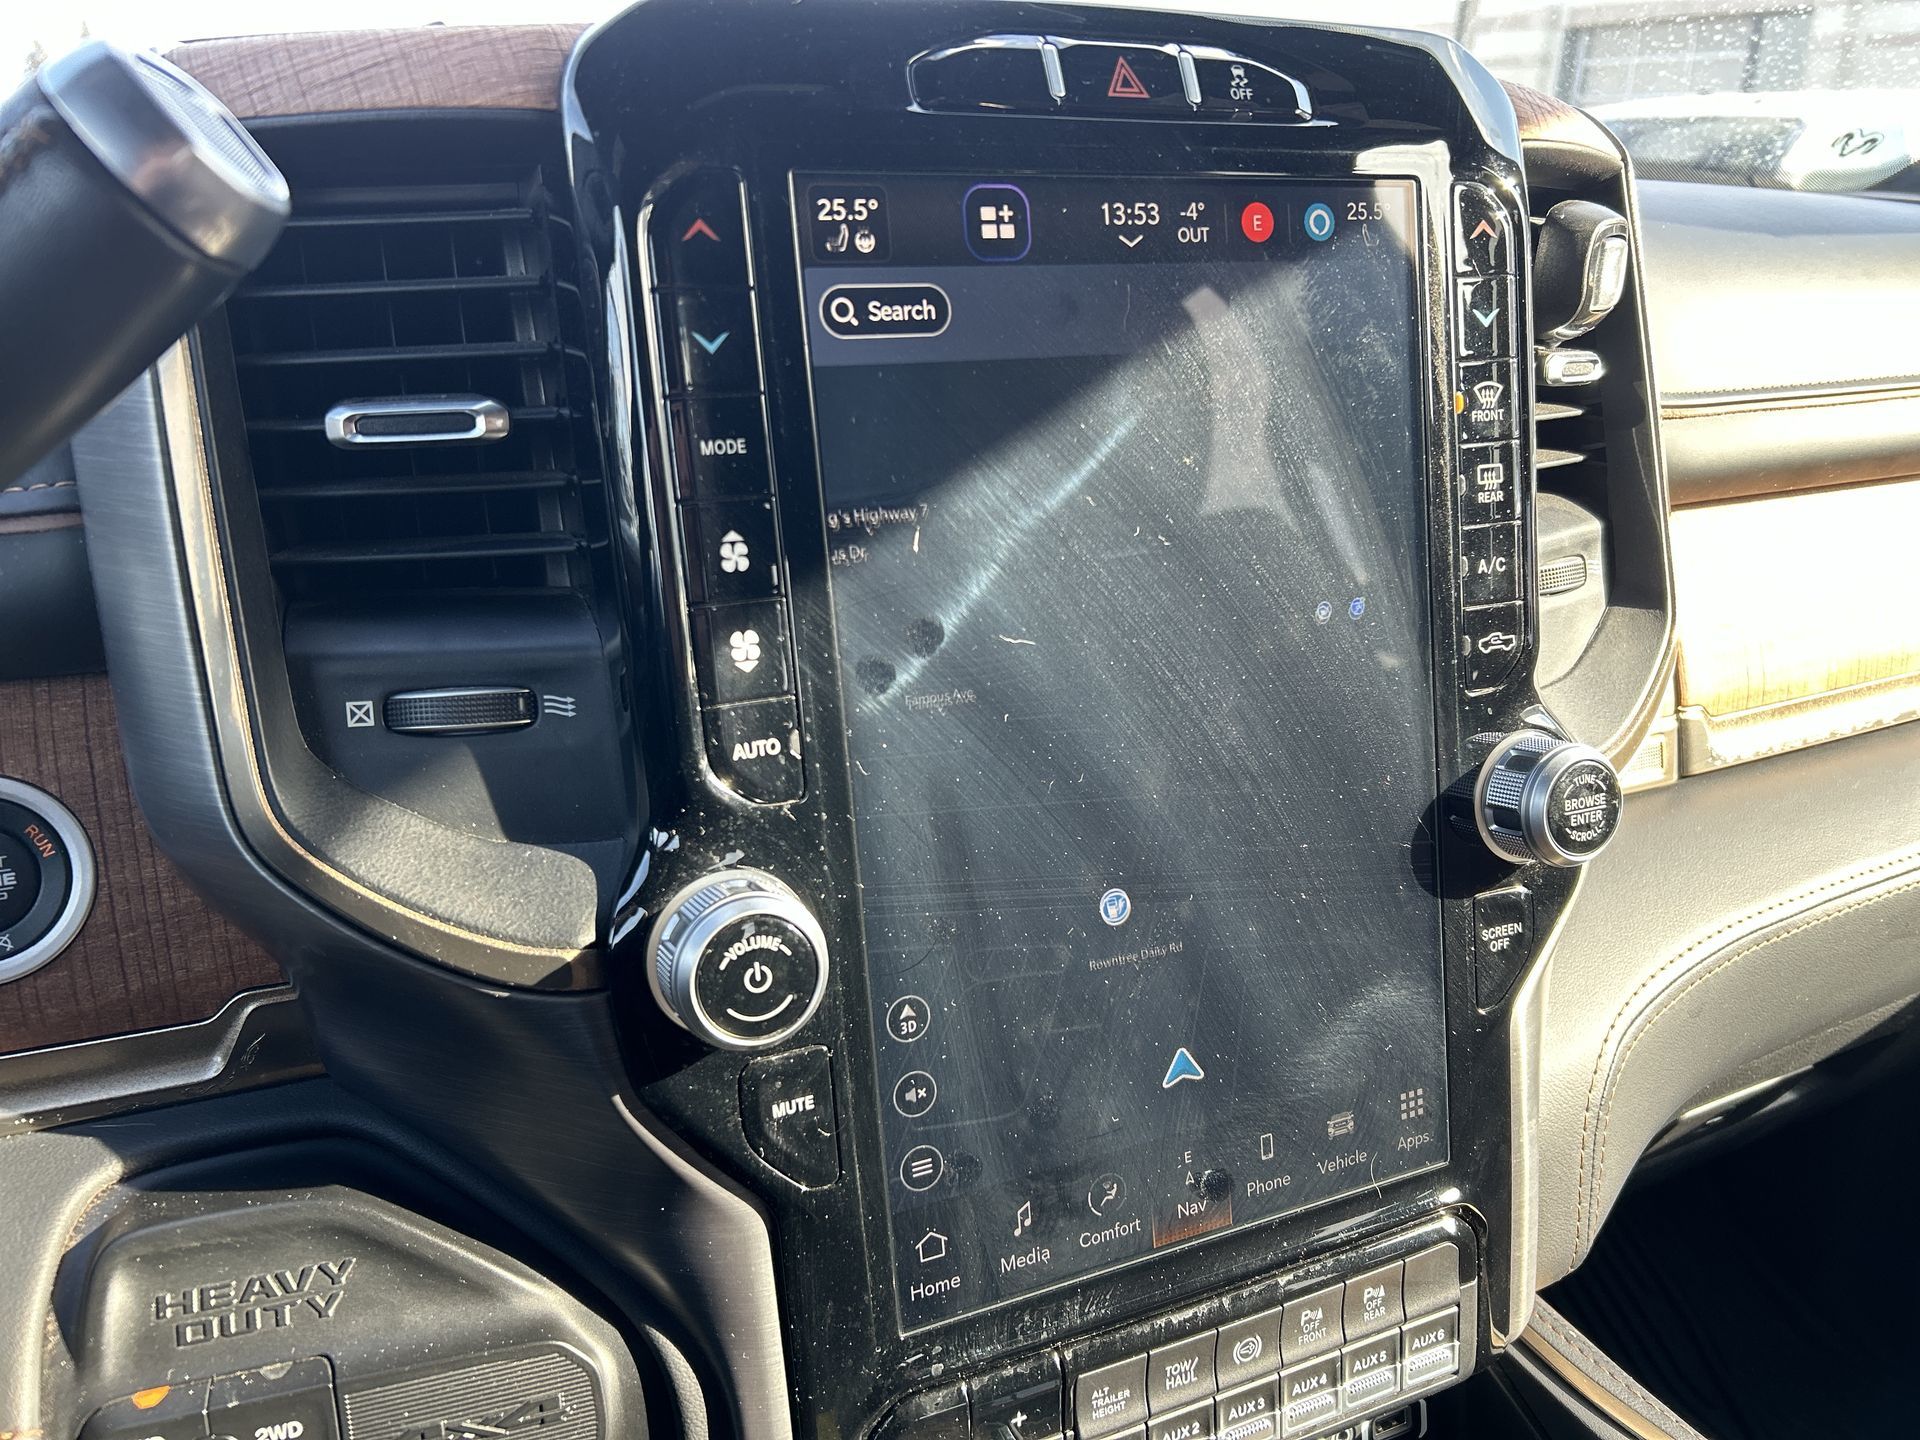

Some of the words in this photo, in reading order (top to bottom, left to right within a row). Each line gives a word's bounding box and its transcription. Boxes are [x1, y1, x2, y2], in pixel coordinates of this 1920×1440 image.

[1230, 87, 1253, 100] OFF
[816, 198, 879, 221] 25.5°
[1100, 202, 1160, 225] 13:53
[1179, 202, 1205, 221] -4°
[1346, 202, 1391, 221] 25.5°
[1252, 214, 1263, 231] E
[1177, 227, 1210, 243] OUT
[867, 299, 937, 322] Search
[1471, 409, 1505, 422] FRONT
[700, 438, 747, 456] MODE
[1477, 490, 1504, 504] REAR
[853, 506, 917, 527] Highway
[919, 503, 929, 519] 7
[1477, 556, 1506, 575] A/C
[732, 738, 781, 761] AUTO
[1573, 773, 1597, 787] TUNE
[1564, 793, 1606, 811] BROWSE
[1570, 809, 1603, 827] ENTER
[24, 824, 56, 860] RUN
[1570, 827, 1602, 842] SCROLL
[1481, 922, 1522, 941] SCREEN
[724, 934, 783, 961] VOLUME
[1489, 937, 1510, 952] OFF
[1088, 953, 1139, 972] Rowntree
[900, 1020, 917, 1035] 3D
[771, 1094, 815, 1119] MUTE
[1398, 1131, 1430, 1152] Apps
[1317, 1150, 1368, 1175] Vehicle
[1247, 1173, 1292, 1197] Phone
[1177, 1199, 1208, 1219] Nav
[1079, 1218, 1142, 1248] Comfort
[1000, 1247, 1051, 1273] Media
[155, 1257, 357, 1321] HEAVY
[910, 1275, 962, 1301] Home
[1364, 1306, 1386, 1322] REAR
[1366, 1298, 1382, 1311] OFF
[175, 1291, 345, 1348] DUTY
[1303, 1322, 1320, 1333] OFF
[1298, 1328, 1327, 1346] FRONT
[1412, 1331, 1438, 1350] AUX
[1437, 1328, 1445, 1341] 6
[1353, 1353, 1380, 1373] AUX
[1379, 1350, 1387, 1363] 5
[1165, 1371, 1198, 1391] HAUL
[1291, 1376, 1319, 1397] AUX
[1319, 1373, 1328, 1386] 4
[1091, 1386, 1110, 1399] ALT
[1091, 1389, 1131, 1409] TRAILER
[1092, 1401, 1126, 1420] HEIGHT
[1228, 1400, 1256, 1421] AUX
[1257, 1397, 1266, 1410] 3
[255, 1420, 304, 1440] 2WD
[1163, 1425, 1191, 1440] AUX
[1191, 1422, 1200, 1435] 2
